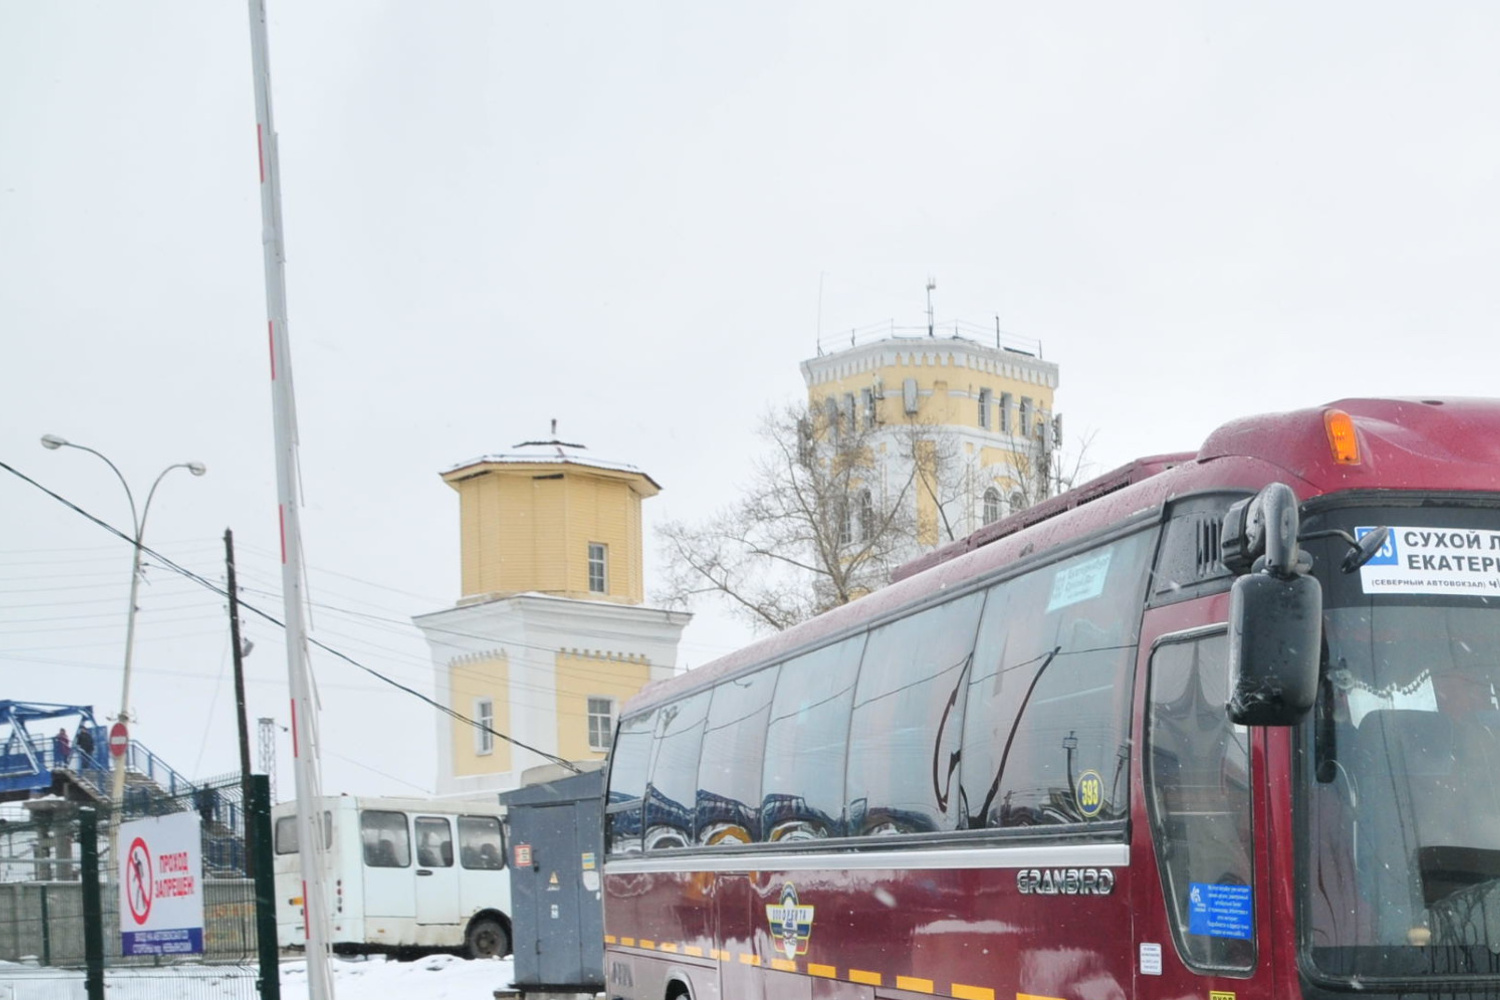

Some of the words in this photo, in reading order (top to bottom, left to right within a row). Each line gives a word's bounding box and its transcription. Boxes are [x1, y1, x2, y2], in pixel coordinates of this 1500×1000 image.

[1404, 530, 1482, 550] СУХОЙ
[1081, 780, 1099, 806] 593
[160, 852, 189, 874] ПРОХОД
[1017, 869, 1115, 895] GRANBIRD
